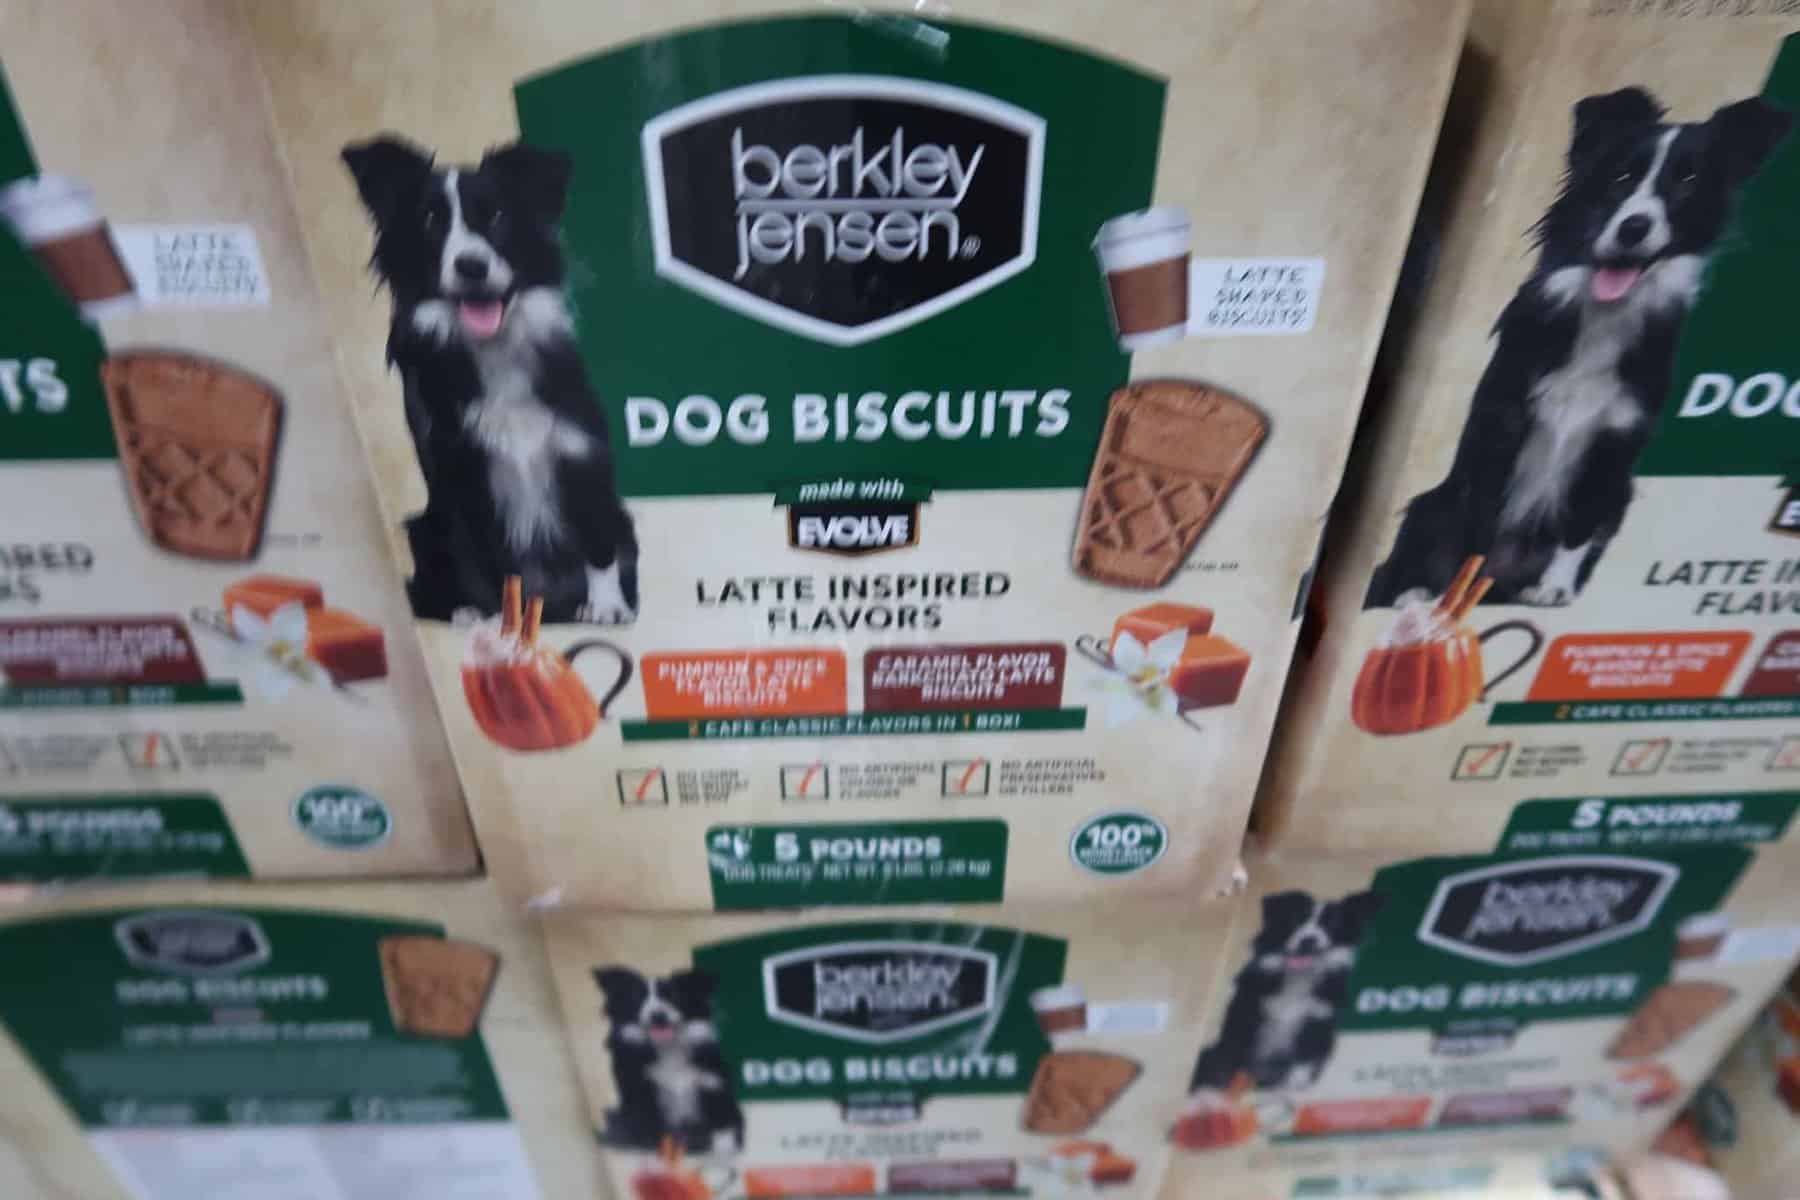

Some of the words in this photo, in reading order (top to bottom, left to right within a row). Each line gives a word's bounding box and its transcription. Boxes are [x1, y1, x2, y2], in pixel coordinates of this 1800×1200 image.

[731, 126, 985, 207] berkley
[1223, 266, 1305, 281] LATTE
[625, 395, 770, 448] DOG
[792, 389, 1072, 444] BISCUITS
[799, 478, 855, 501] made
[862, 478, 905, 500] with
[799, 515, 909, 546] EVOLVE
[1644, 560, 1768, 586] LATTE
[696, 576, 815, 605] LATTE
[829, 572, 1012, 601] INSPIRED
[767, 603, 943, 634] FLAVORS
[658, 660, 750, 680] PUMPKIN
[877, 655, 971, 674] CARAMEL
[975, 652, 1051, 671] FLAVOR
[998, 666, 1055, 684] LATTE
[922, 681, 1007, 702] BISCUITS
[846, 715, 932, 735] FLAVORS
[937, 715, 958, 731] IN
[962, 713, 971, 729] 1
[975, 713, 1021, 730] BOX!
[1571, 800, 1605, 828] 5
[775, 832, 800, 862] 5
[810, 836, 943, 862] POUNDS
[1357, 985, 1450, 1012] DOG
[1459, 971, 1639, 1009] BISCUITS
[742, 1056, 833, 1085] DOG
[845, 1053, 1018, 1082] BISCUITS
